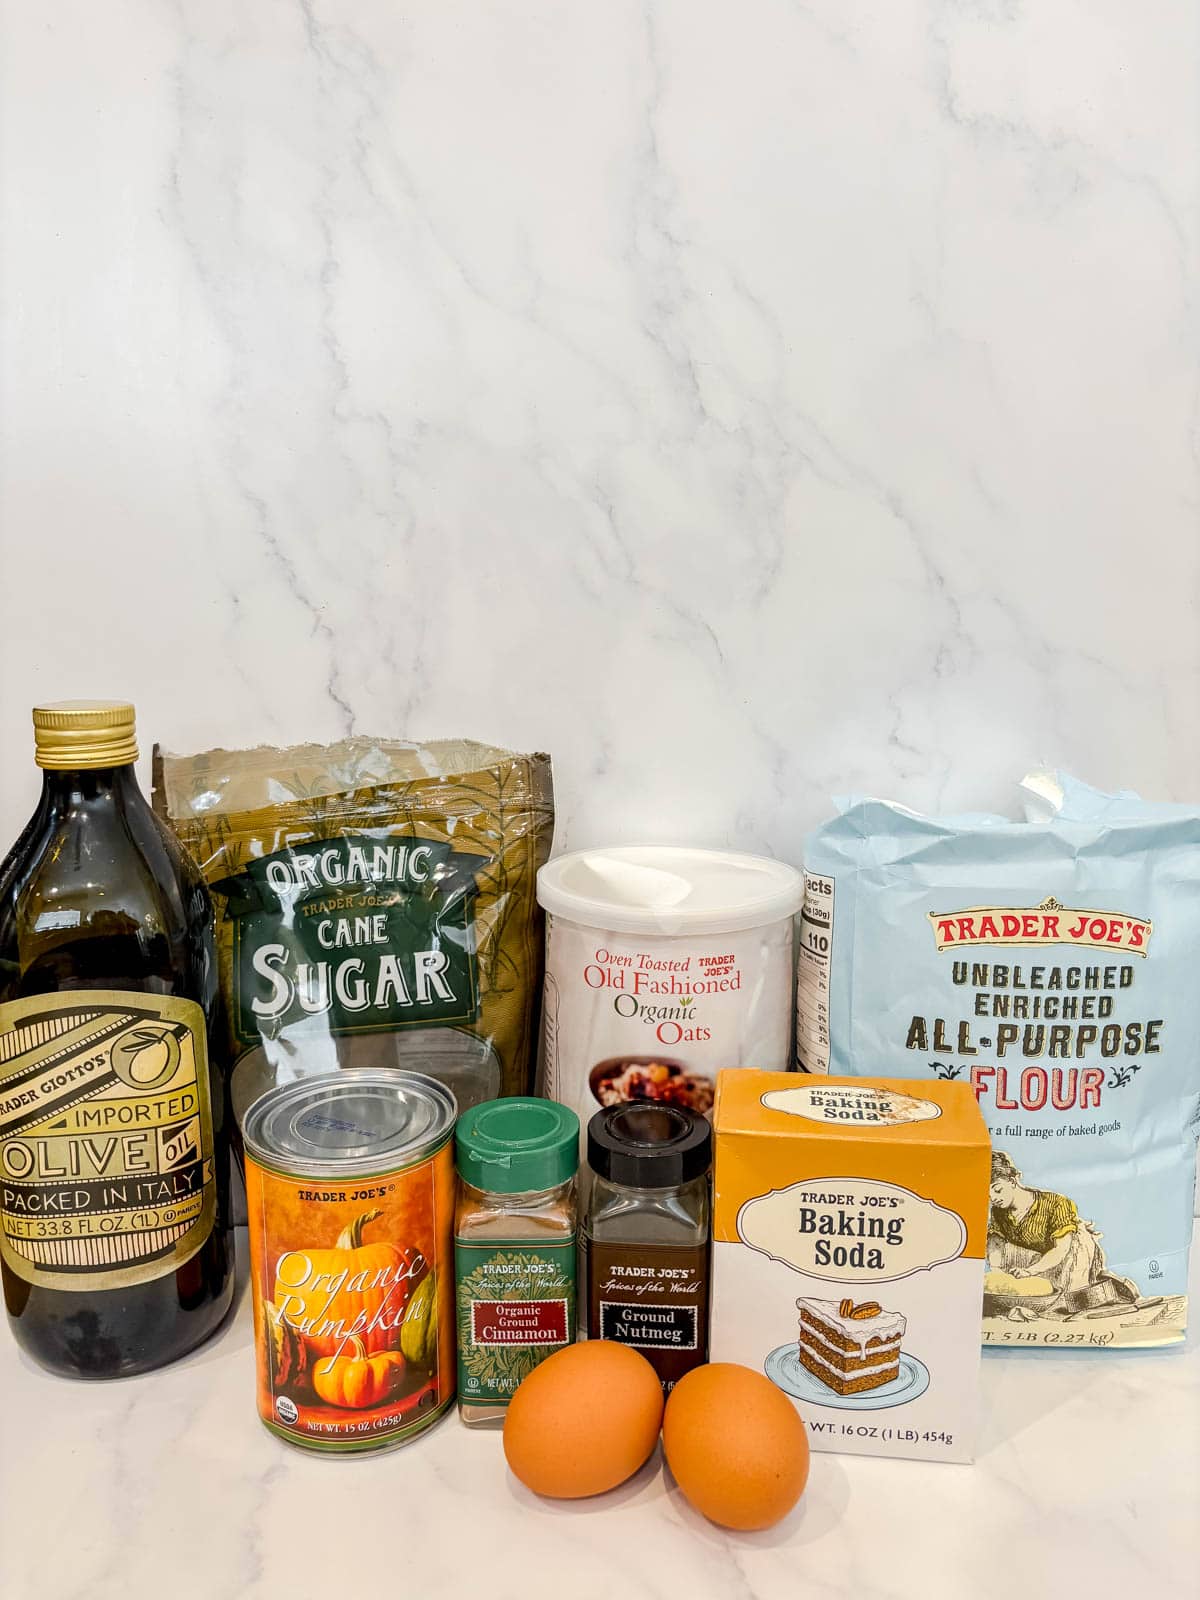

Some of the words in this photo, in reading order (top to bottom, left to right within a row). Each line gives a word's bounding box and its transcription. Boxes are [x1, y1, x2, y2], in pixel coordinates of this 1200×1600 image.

[266, 846, 432, 894] ORGANIC
[303, 896, 353, 917] TRADER
[318, 914, 390, 949] CANE
[809, 932, 828, 952] 110
[937, 915, 1060, 942] TRADER
[1068, 916, 1146, 946] JOE'S
[596, 949, 632, 967] Oven
[637, 954, 691, 972] Toasted
[699, 955, 735, 967] TRADER
[703, 966, 730, 977] JOE'S
[251, 944, 457, 1020] SUGAR
[584, 965, 624, 988] Old
[633, 971, 741, 995] Fashioned
[952, 961, 1135, 990] UNBLEACHED
[614, 994, 697, 1024] Organic
[974, 993, 1114, 1019] ENRICHED
[656, 1022, 711, 1044] Oats
[905, 1016, 1164, 1058] ALL-PURPOSE
[0, 1089, 40, 1115] RADER
[40, 1053, 106, 1093] GIOTTO'S
[969, 1065, 1105, 1111] FLOUR
[75, 1095, 194, 1127] IMPORTED
[809, 1096, 893, 1112] Baking
[823, 1108, 880, 1121] Soda
[995, 1126, 1002, 1135] a
[1005, 1125, 1022, 1136] full
[1025, 1128, 1053, 1139] range
[1056, 1125, 1067, 1137] of
[1069, 1123, 1096, 1136] baked
[1098, 1120, 1121, 1136] goods
[3, 1134, 150, 1178] OLIVE
[166, 1131, 195, 1161] OIL
[4, 1189, 90, 1211] PACKED
[104, 1186, 128, 1206] IN
[137, 1170, 196, 1201] ITALY
[298, 1190, 346, 1201] TRADER
[351, 1186, 387, 1200] JOE'S
[801, 1193, 855, 1206] TRADER
[860, 1196, 899, 1208] JOE'S
[8, 1221, 34, 1236] NET
[37, 1221, 72, 1236] 33.8
[131, 1211, 159, 1229] (1L)
[799, 1208, 905, 1245] Baking
[815, 1240, 885, 1269] Soda
[276, 1249, 427, 1310] Organic
[483, 1264, 521, 1274] TRADER
[524, 1264, 555, 1273] JOE'S
[610, 1266, 655, 1278] TRADER
[657, 1269, 689, 1278] JOE'S
[476, 1278, 504, 1291] Spices
[537, 1275, 568, 1288] World
[600, 1279, 635, 1294] Spices
[635, 1281, 652, 1296] of
[648, 1282, 665, 1292] the
[669, 1281, 702, 1293] World
[496, 1305, 541, 1317] Organic
[499, 1317, 539, 1327] Ground
[622, 1309, 675, 1323] Ground
[274, 1288, 424, 1371] Pumpkin
[482, 1326, 558, 1340] Cinnamon
[615, 1323, 684, 1343] Nutmeg
[982, 1331, 995, 1341] T.
[1001, 1332, 1012, 1341] 5
[1016, 1332, 1038, 1341] LB
[1044, 1332, 1085, 1343] (2.27
[1089, 1331, 1115, 1346] kg)
[307, 1421, 322, 1431] NET
[325, 1424, 341, 1433] WT.
[345, 1423, 356, 1433] 15
[357, 1421, 370, 1431] OZ
[373, 1413, 402, 1429] (425g)
[810, 1422, 837, 1434] WT.
[841, 1425, 854, 1435] 16
[857, 1427, 878, 1438] OZ
[882, 1429, 892, 1441] (1
[897, 1430, 919, 1443] LB)
[922, 1432, 953, 1445] 454g
